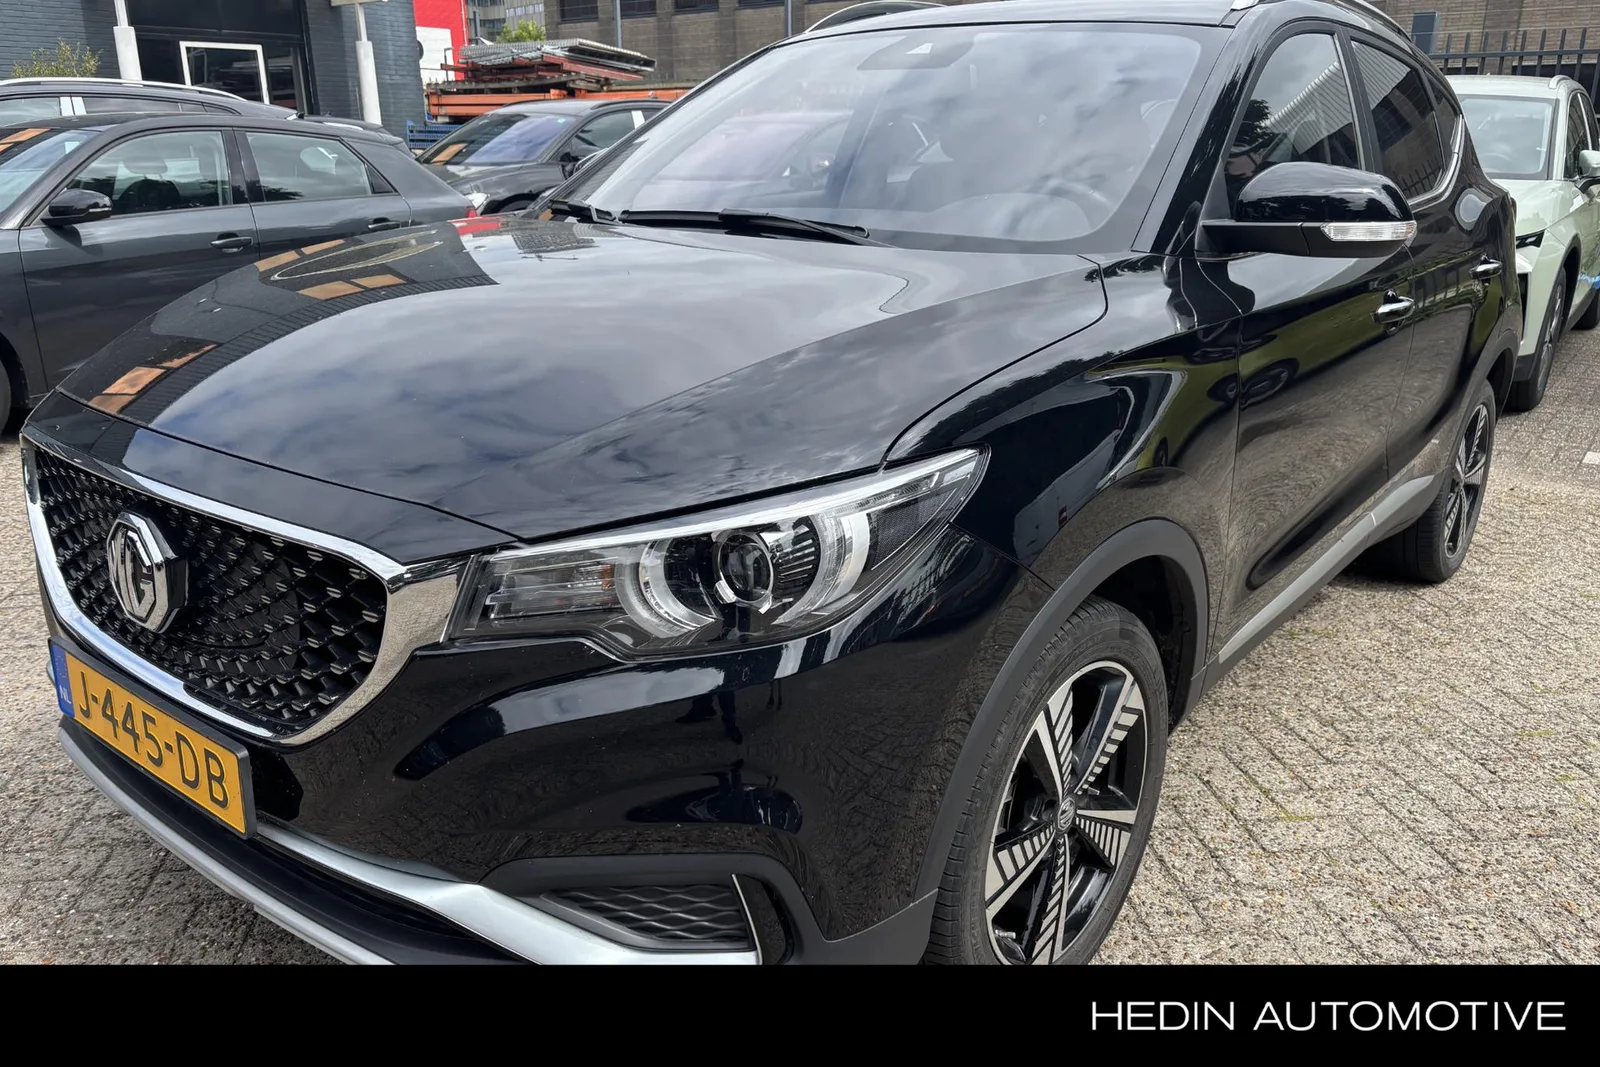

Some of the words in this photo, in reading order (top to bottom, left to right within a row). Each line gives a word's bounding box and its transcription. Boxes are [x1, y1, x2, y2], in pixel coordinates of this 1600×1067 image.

[108, 521, 157, 622] MG
[59, 684, 72, 704] NL
[79, 670, 230, 809] J-445-DB
